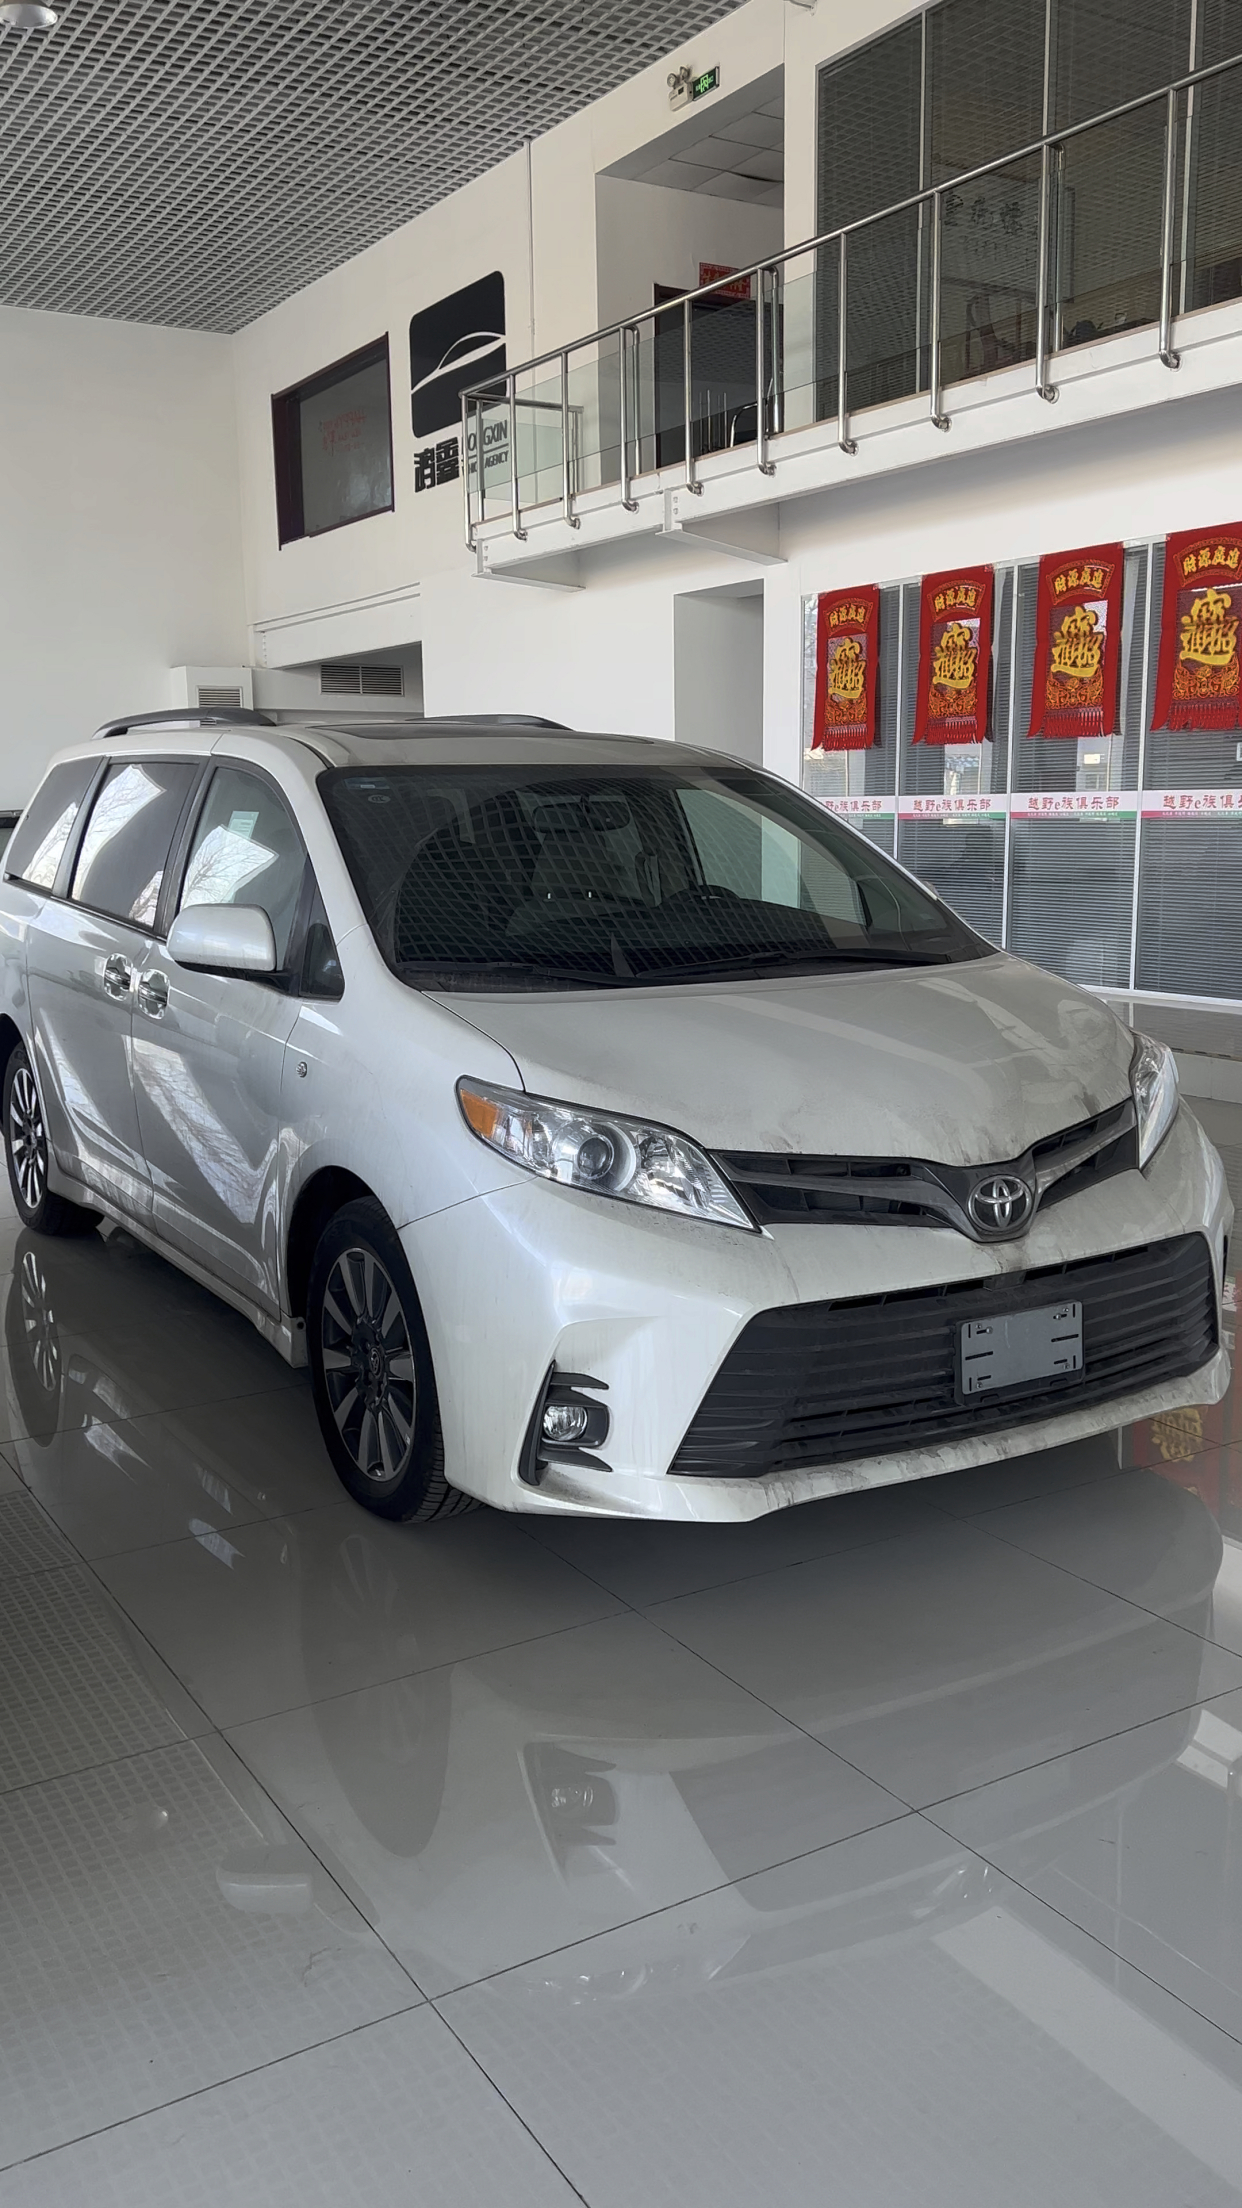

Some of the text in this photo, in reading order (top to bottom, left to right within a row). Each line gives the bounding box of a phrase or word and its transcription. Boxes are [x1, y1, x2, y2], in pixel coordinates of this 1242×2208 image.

[461, 419, 508, 455] OGXIN
[484, 450, 509, 469] AGENCY
[913, 798, 992, 812] 越野e族俱乐部
[1028, 795, 1120, 810] 越野e族俱乐部
[1163, 794, 1242, 809] 越野e族俱
